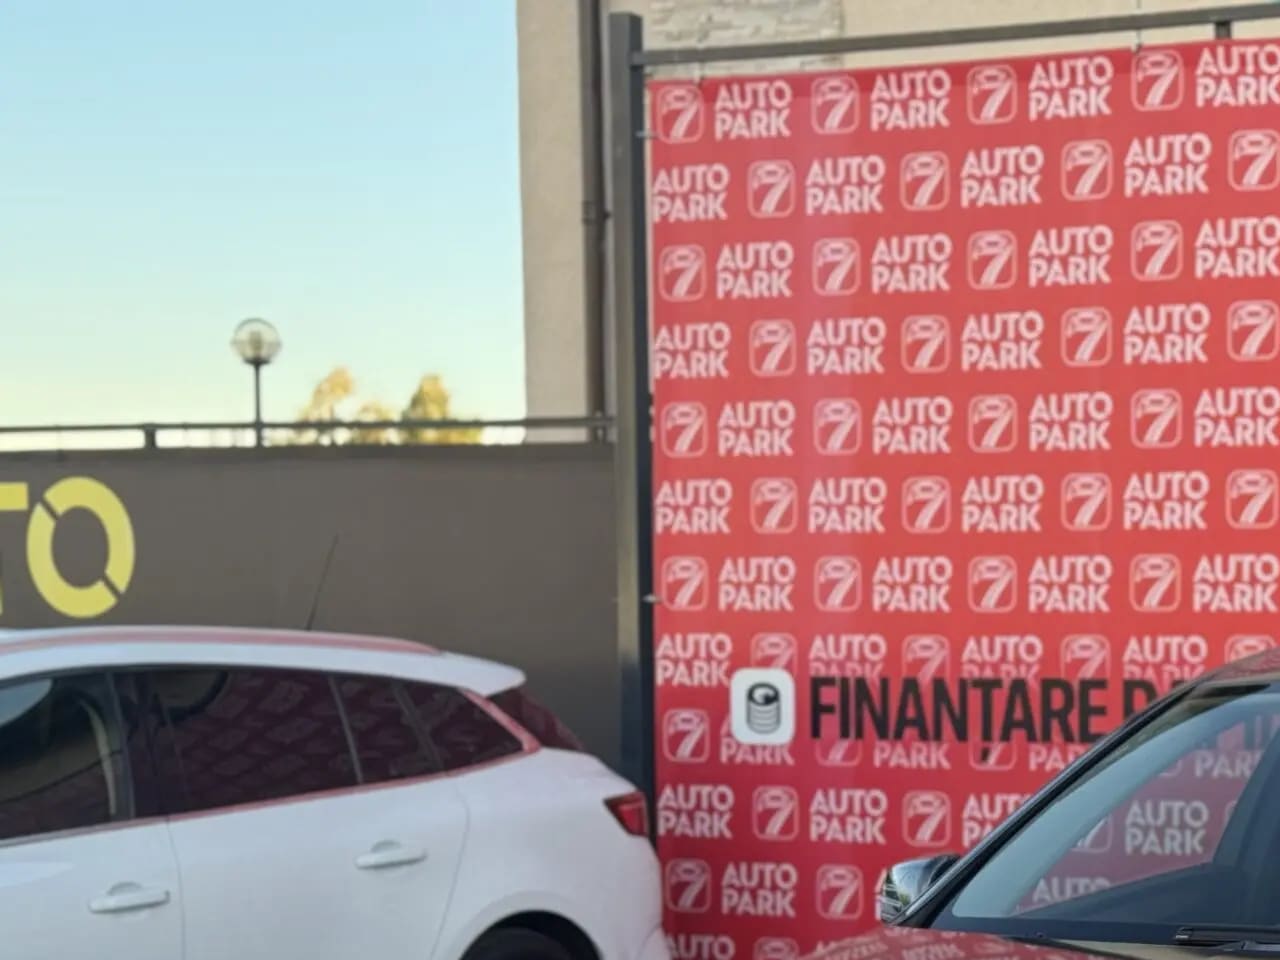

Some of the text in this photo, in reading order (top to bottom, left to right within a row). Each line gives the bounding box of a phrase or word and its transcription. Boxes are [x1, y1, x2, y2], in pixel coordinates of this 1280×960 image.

[871, 70, 951, 102] AUTO
[1028, 56, 1114, 90] AUTO
[714, 80, 792, 111] AUTO
[1028, 87, 1110, 121] PARK
[715, 110, 791, 141] PARK
[871, 99, 950, 131] PARK
[961, 145, 1044, 177] AUTO
[1124, 134, 1211, 167] AUTO
[653, 164, 729, 195] AUTO
[806, 156, 885, 187] AUTO
[1125, 164, 1208, 197] PARK
[807, 184, 883, 215] PARK
[961, 175, 1042, 207] PARK
[653, 192, 728, 223] PARK
[716, 242, 793, 272] AUTO
[871, 234, 953, 265] AUTO
[1028, 226, 1113, 258] AUTO
[1029, 255, 1110, 288] PARK
[1196, 246, 1280, 279] PARK
[717, 270, 792, 299] PARK
[872, 263, 950, 294] PARK
[807, 318, 886, 347] AUTO
[961, 311, 1043, 342] AUTO
[1124, 305, 1211, 336] AUTO
[654, 323, 730, 351] AUTO
[1125, 332, 1207, 365] PARK
[655, 349, 728, 379] PARK
[808, 345, 884, 375] PARK
[962, 340, 1041, 371] PARK
[718, 401, 795, 429] AUTO
[872, 397, 953, 426] AUTO
[1028, 392, 1113, 423] AUTO
[719, 428, 793, 456] PARK
[873, 424, 951, 454] PARK
[1029, 421, 1110, 452] PARK
[1195, 415, 1280, 448] PARK
[655, 479, 732, 507] AUTO
[808, 478, 887, 506] AUTO
[961, 475, 1043, 505] AUTO
[1123, 472, 1209, 502] AUTO
[656, 505, 730, 534] PARK
[809, 504, 885, 534] PARK
[962, 503, 1041, 533] PARK
[1124, 499, 1206, 530] PARK
[718, 557, 796, 585] AUTO
[872, 557, 953, 585] AUTO
[1028, 556, 1113, 586] AUTO
[1193, 555, 1280, 584] AUTO
[719, 583, 793, 612] PARK
[873, 583, 951, 613] PARK
[1029, 584, 1110, 614] PARK
[1194, 581, 1279, 613] PARK
[656, 633, 732, 661] AUTO
[808, 635, 887, 663] AUTO
[961, 635, 1042, 664] AUTO
[1123, 635, 1207, 663] AUTO
[656, 660, 731, 688] PARK
[810, 676, 1107, 743] FINANTARE
[874, 742, 951, 770] PARK
[658, 785, 734, 814] AUTO
[810, 789, 887, 818] AUTO
[1125, 800, 1209, 826] AUTO
[659, 812, 732, 838] PARK
[811, 815, 886, 845] PARK
[1124, 827, 1206, 856] PARK
[721, 863, 797, 891] AUTO
[722, 888, 796, 918] PARK
